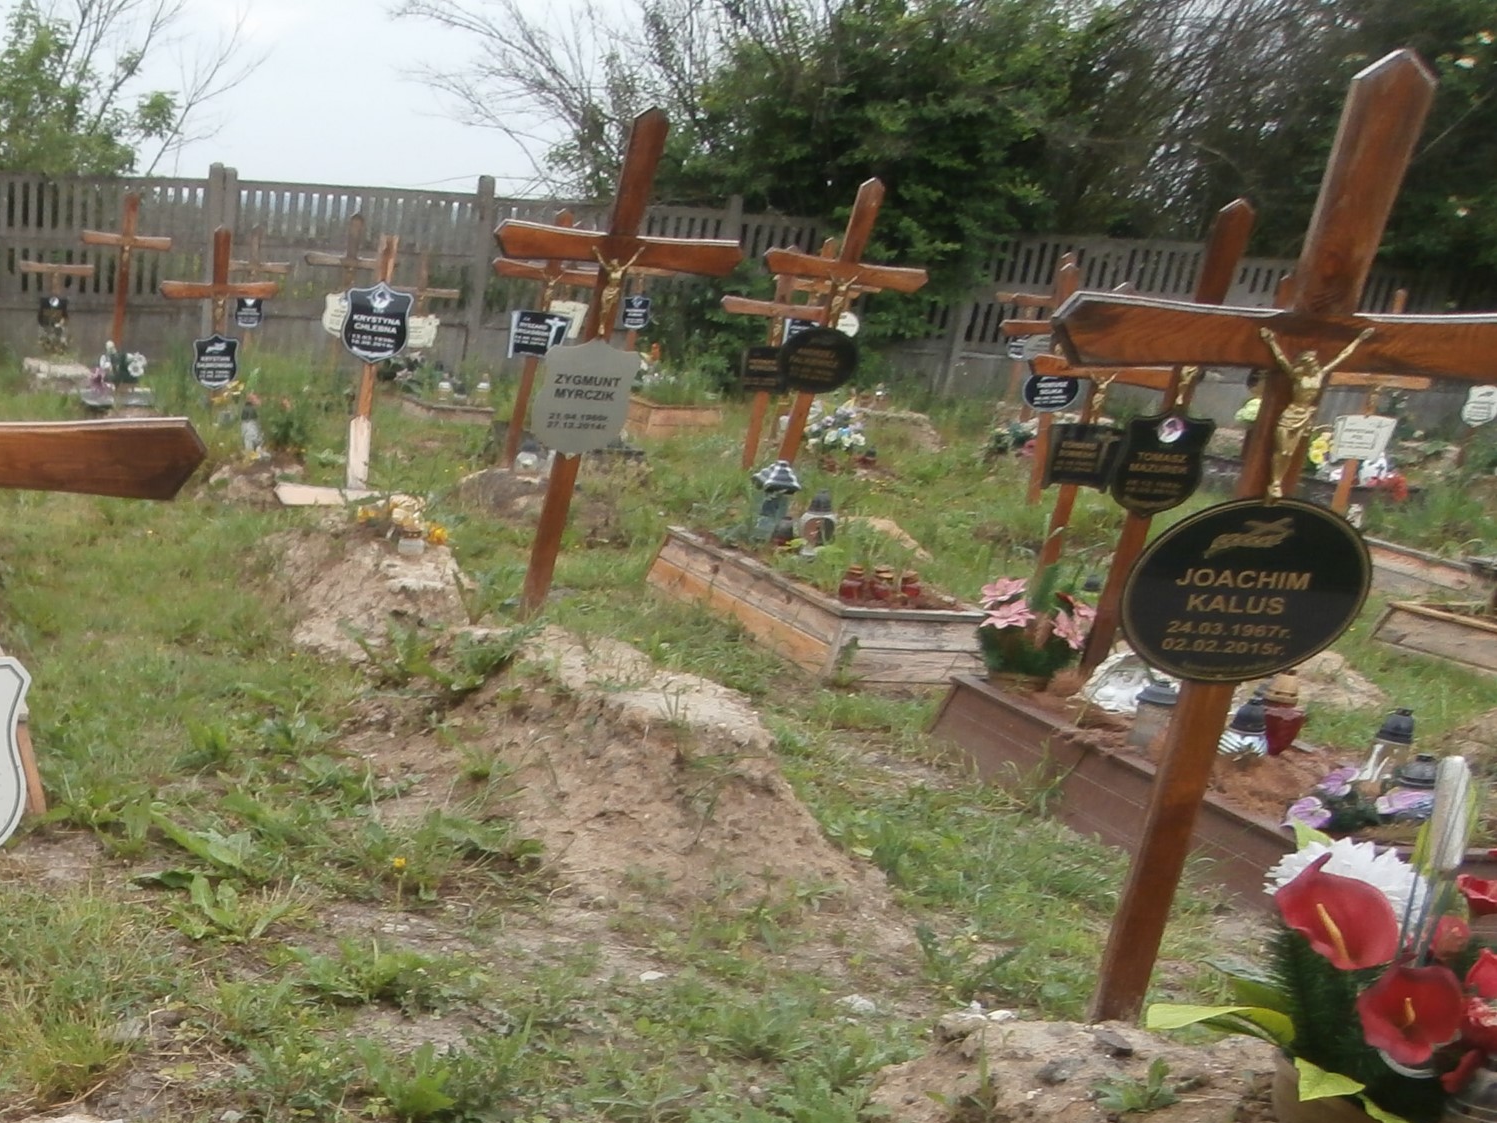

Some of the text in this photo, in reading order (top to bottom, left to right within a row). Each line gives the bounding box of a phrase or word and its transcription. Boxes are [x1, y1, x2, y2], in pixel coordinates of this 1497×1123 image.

[352, 314, 401, 326] KRYSTYNA
[554, 373, 621, 388] ZYGMUNT
[554, 388, 615, 401] MYRCZIK
[1138, 452, 1190, 463] TOMASZ
[1175, 568, 1313, 591] JOACHIM
[1186, 594, 1286, 615] KALUS
[1166, 620, 1291, 639] 24.03.1967r.
[1161, 638, 1285, 656] 02.02.2015r.
